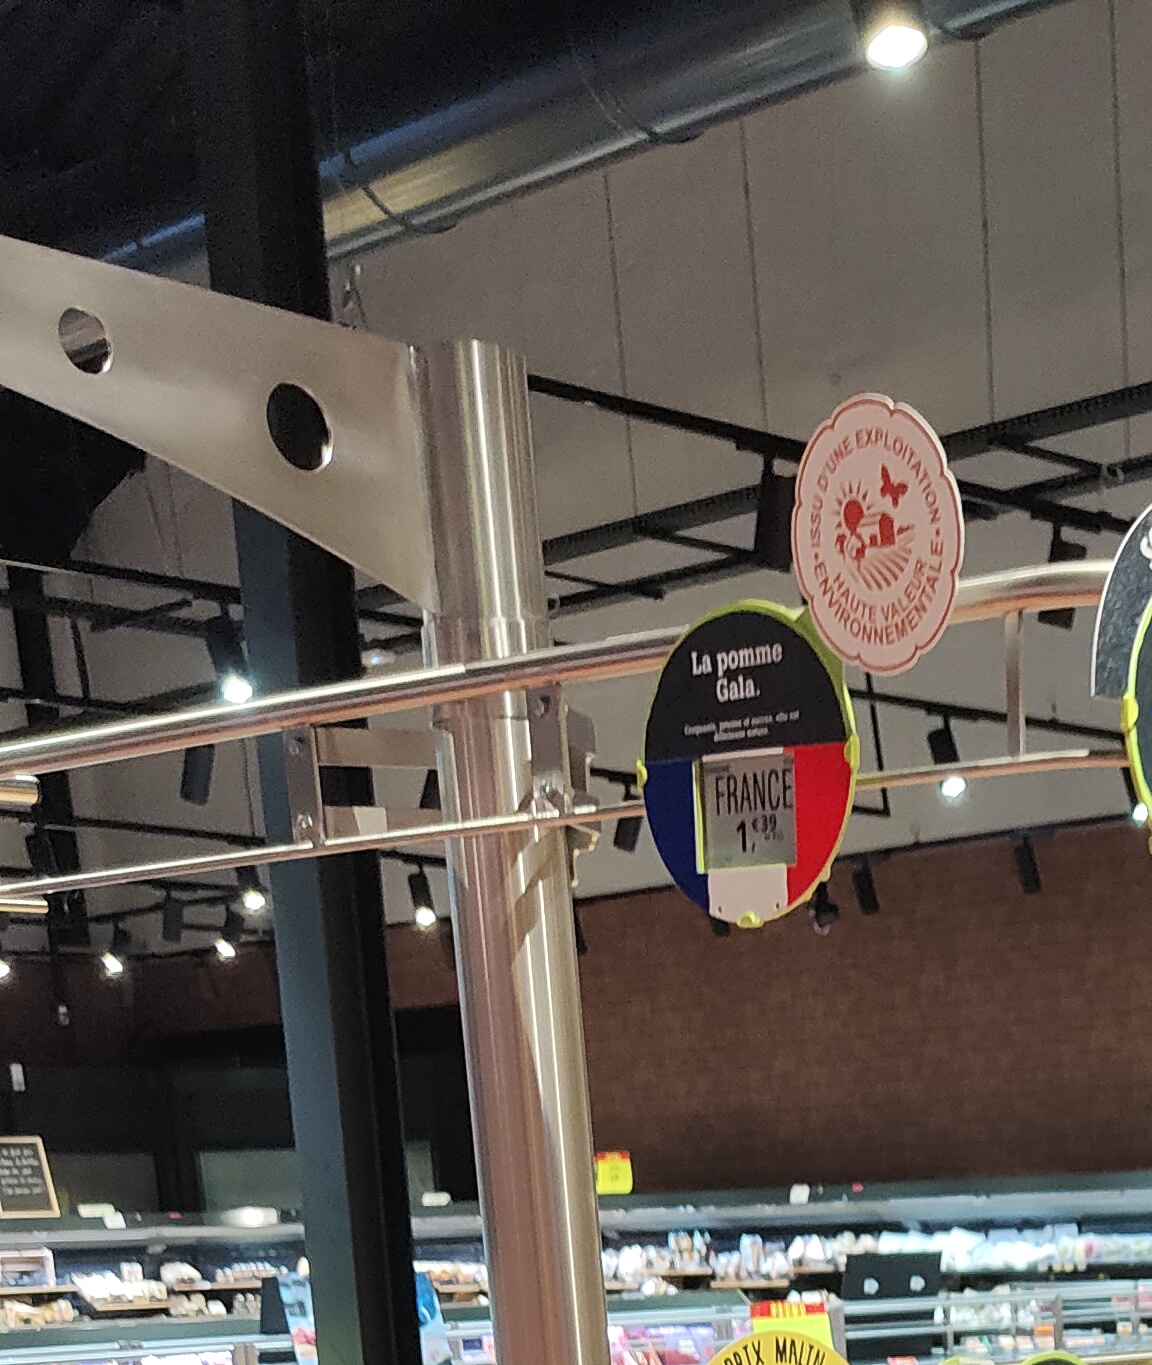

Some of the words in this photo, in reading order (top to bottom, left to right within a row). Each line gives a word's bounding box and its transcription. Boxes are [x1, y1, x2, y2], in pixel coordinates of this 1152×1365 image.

[816, 437, 854, 493] D'UNE
[855, 427, 940, 523] EXPLOITATION
[811, 498, 823, 548] ISSU
[814, 539, 944, 645] ENVIRONNEMENTALE
[833, 572, 876, 622] HAUTE
[881, 559, 926, 622] VALEUR
[691, 651, 712, 676] La
[717, 642, 783, 677] pomme
[716, 674, 761, 703] Gala.
[715, 769, 793, 816] FRANCE
